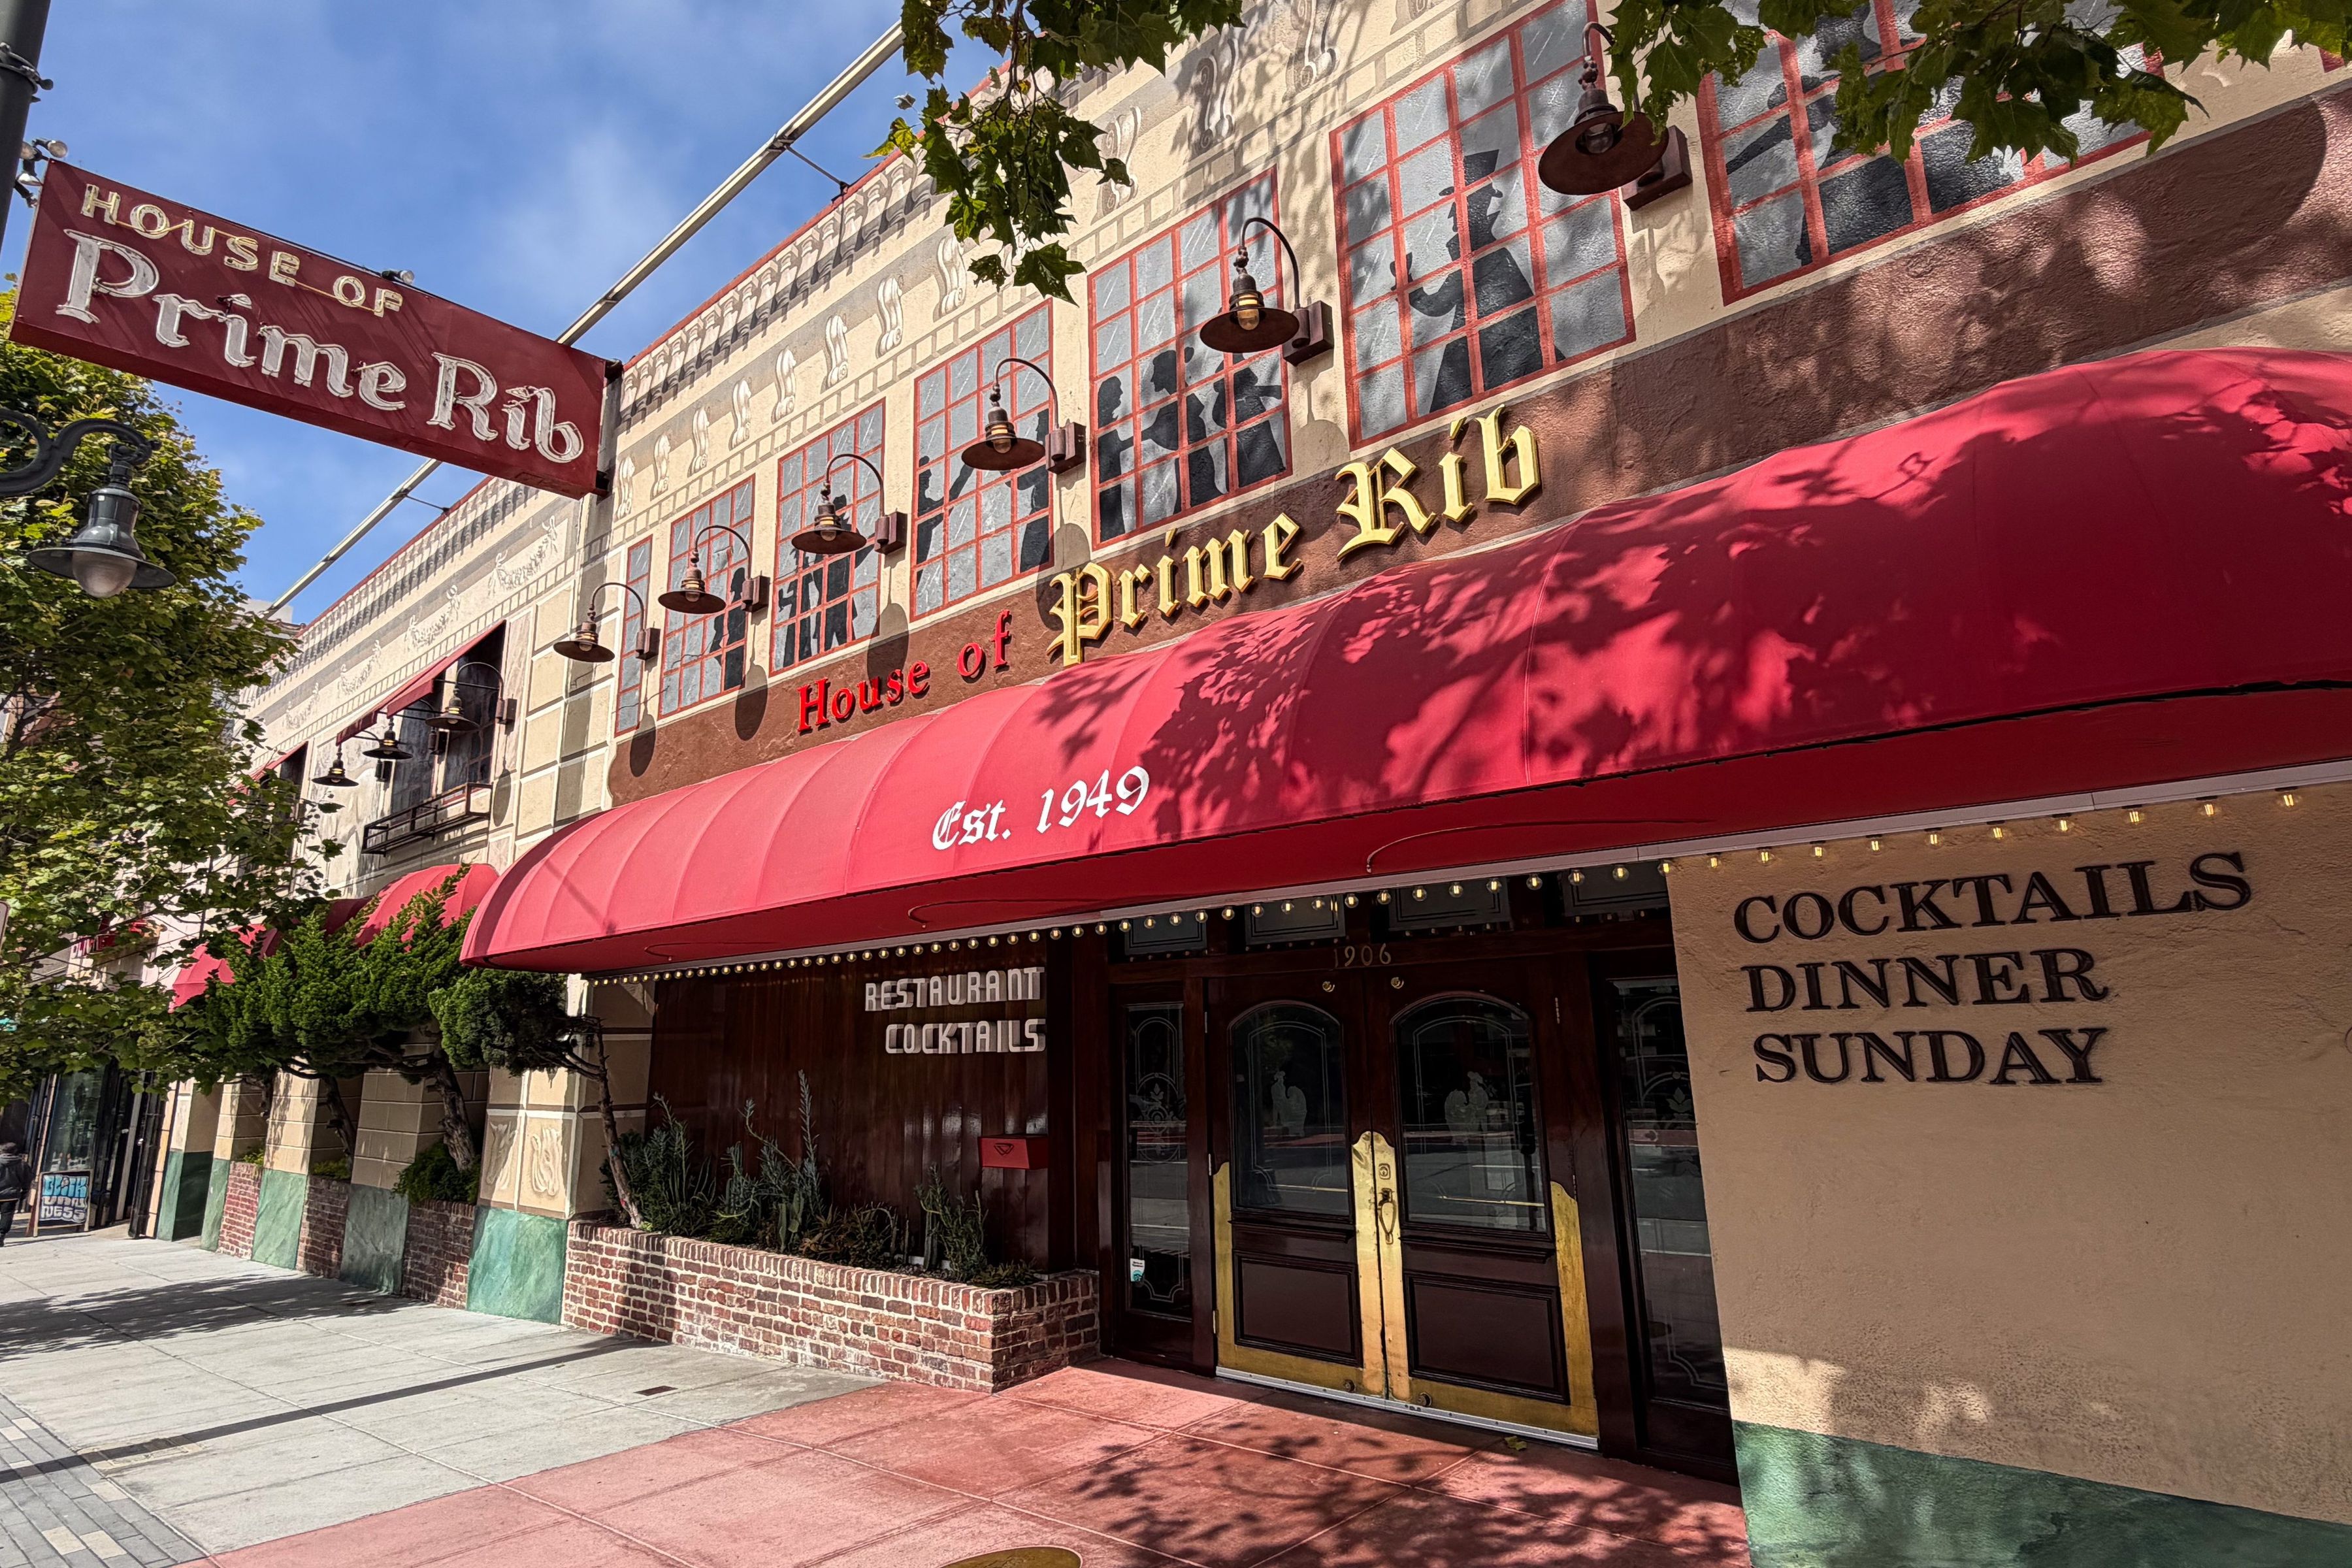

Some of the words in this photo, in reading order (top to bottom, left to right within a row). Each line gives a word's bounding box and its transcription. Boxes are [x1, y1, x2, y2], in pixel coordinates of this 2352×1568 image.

[80, 183, 301, 287] HOUSE
[332, 275, 404, 318] OF
[55, 229, 408, 412] Prime
[427, 351, 584, 464] Rib
[796, 660, 930, 733] House
[956, 609, 1012, 678] of
[1046, 512, 1303, 667] Prime
[1334, 403, 1541, 562] Rib
[932, 799, 1012, 851] Est.
[1036, 765, 1150, 834] 1949
[1733, 851, 2252, 944] COCKTAILS
[865, 966, 1045, 1011] RESTAURANT
[1334, 942, 1392, 968] 1906
[1740, 948, 2109, 1013] DINNER
[885, 1019, 1046, 1054] COCKTAILS
[1754, 1028, 2108, 1086] SUNDAY
